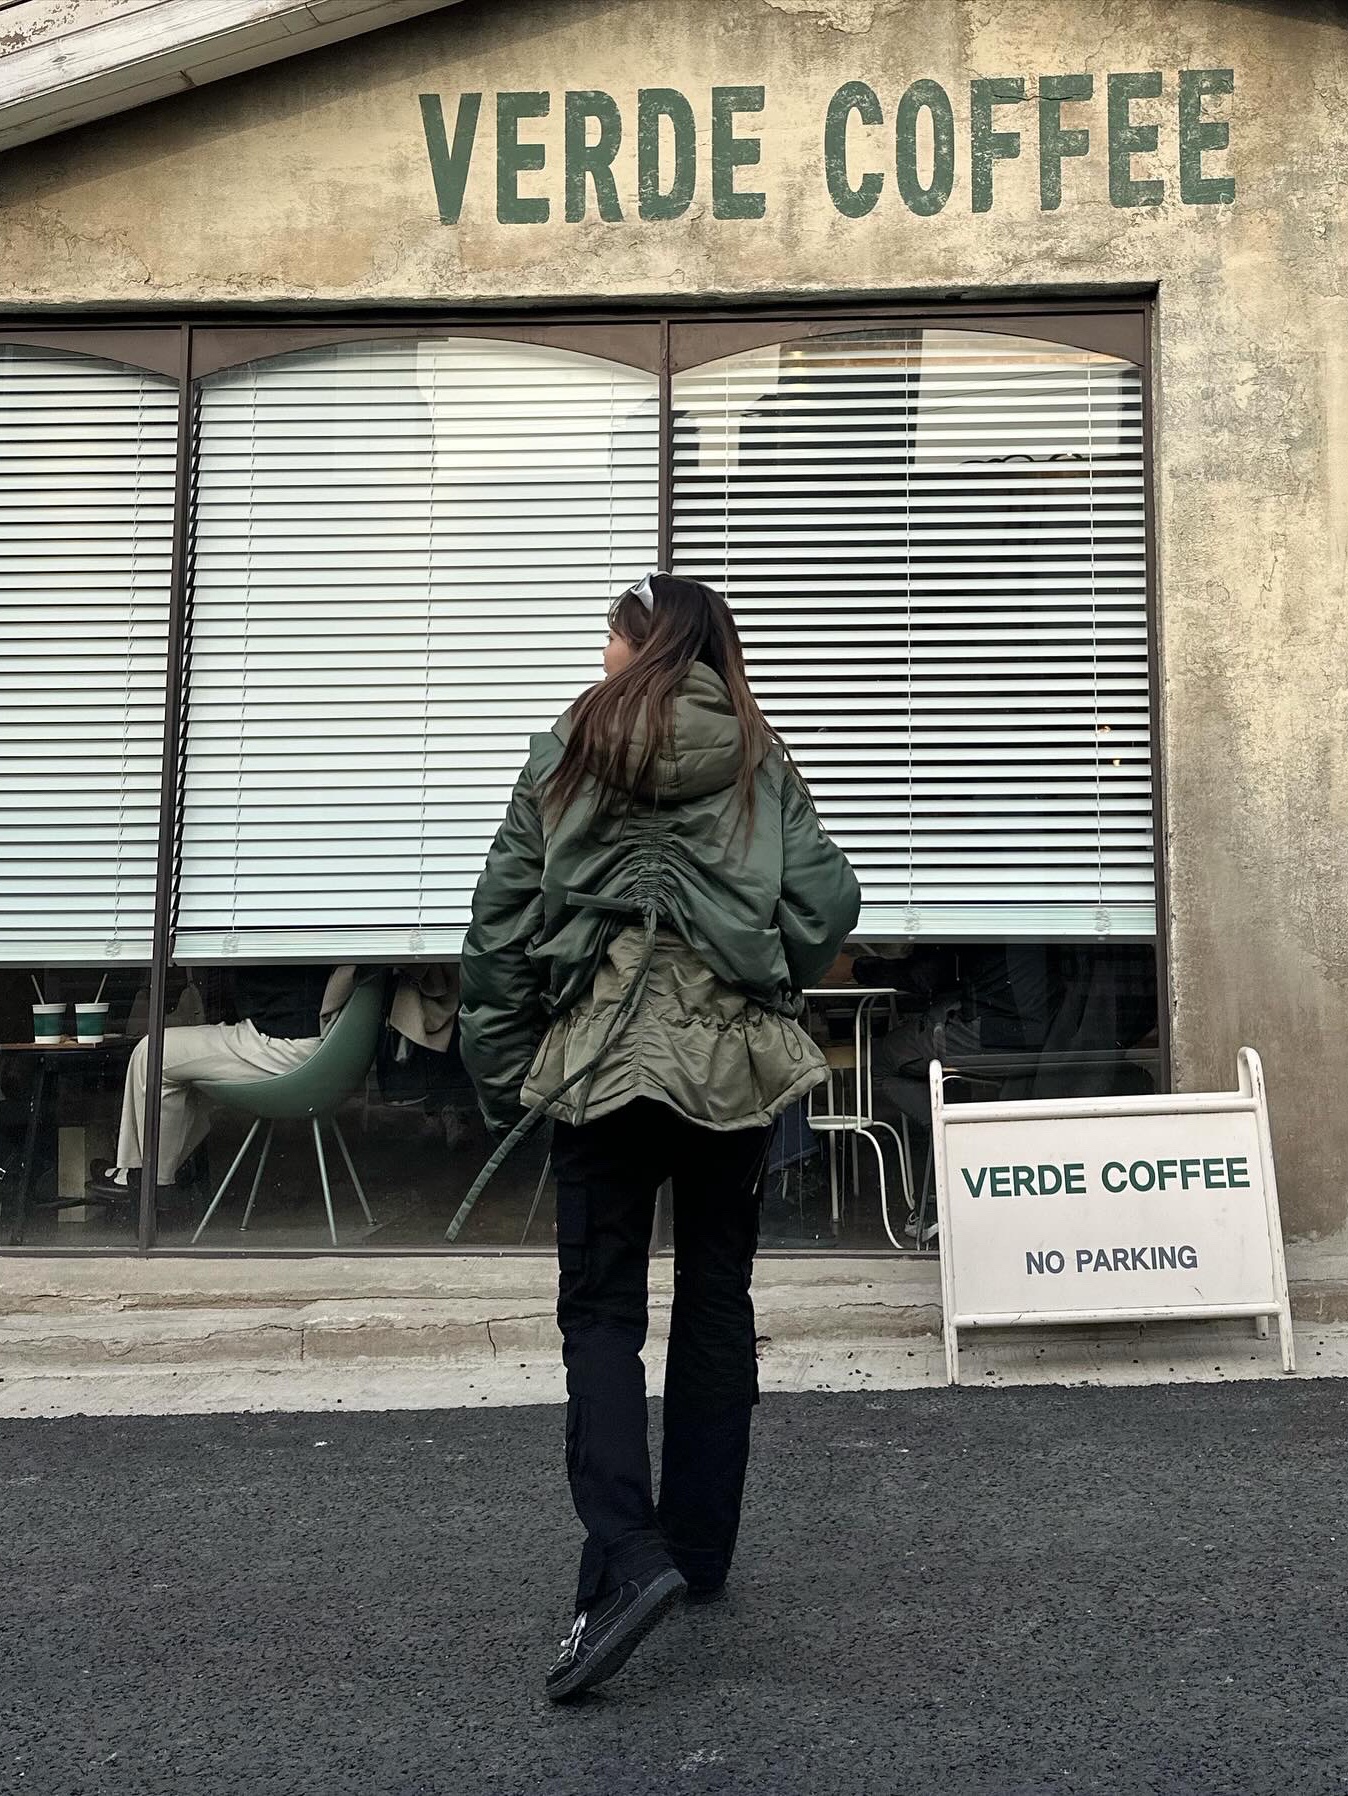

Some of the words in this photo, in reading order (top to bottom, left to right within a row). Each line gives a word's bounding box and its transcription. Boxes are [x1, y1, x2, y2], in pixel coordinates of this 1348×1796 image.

[418, 85, 767, 226] VERDE
[824, 68, 1236, 219] COFFEE
[961, 1163, 1087, 1198] VERDE
[1101, 1157, 1250, 1194] COFFEE
[1026, 1250, 1065, 1275] NO
[1076, 1245, 1198, 1273] PARKING
